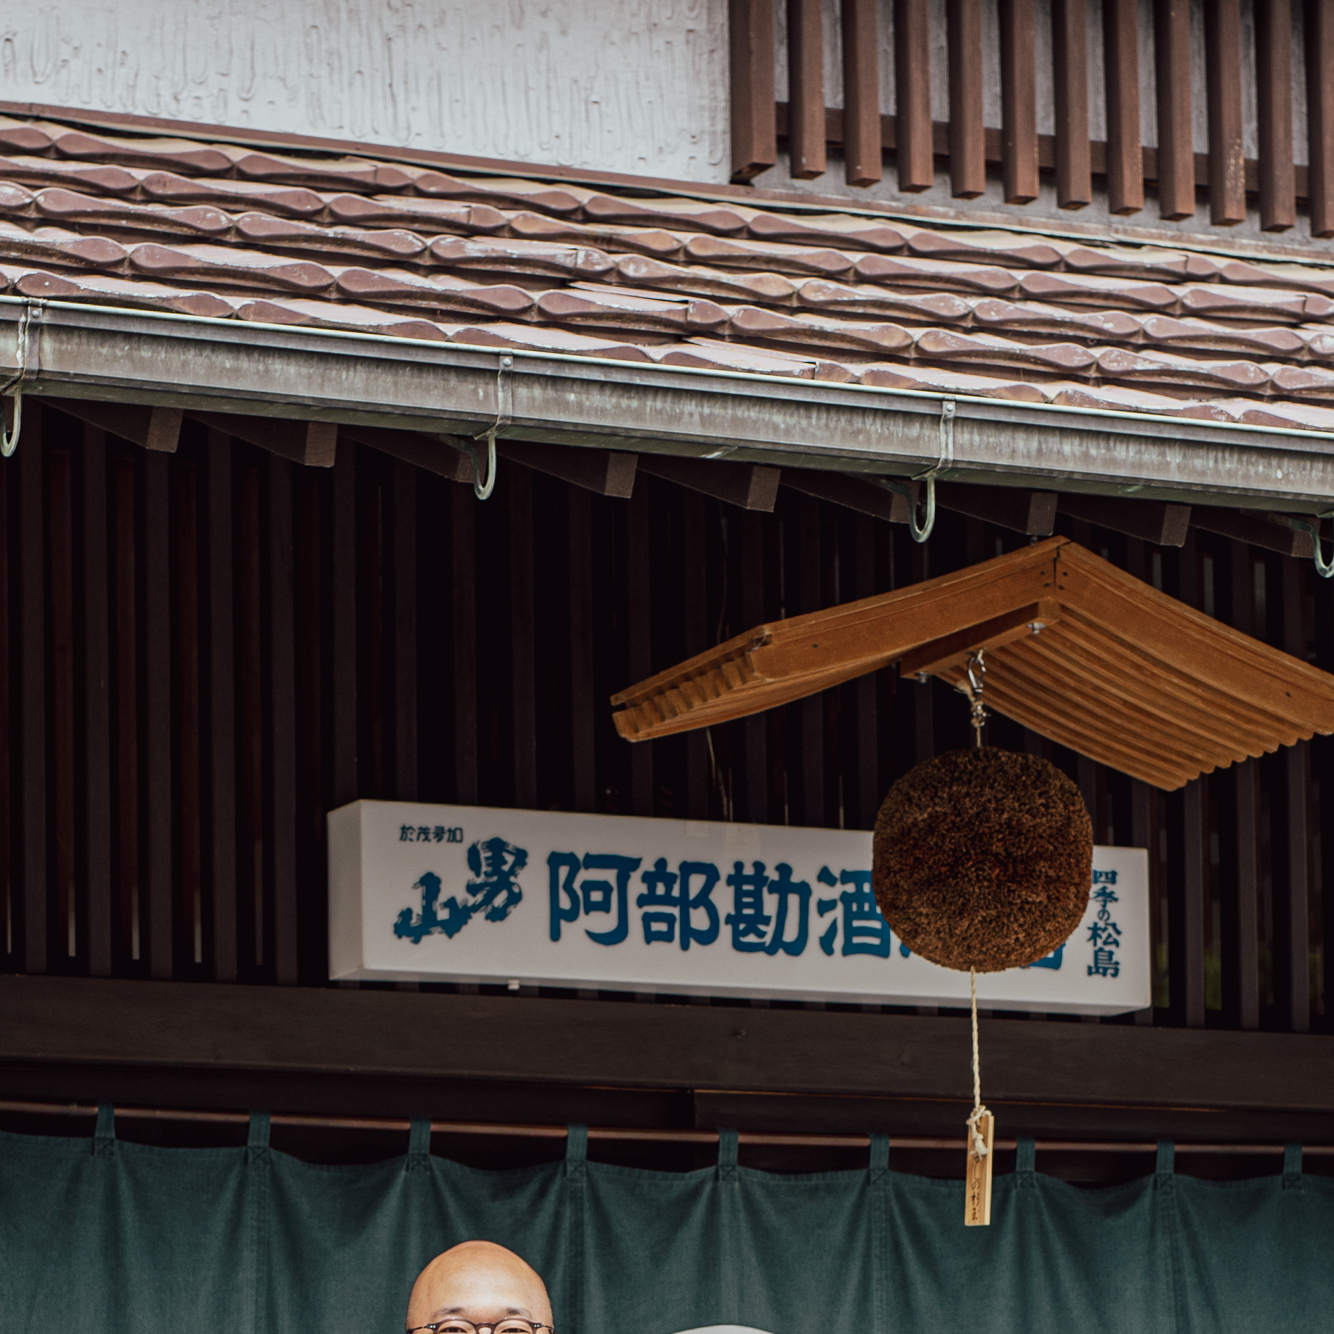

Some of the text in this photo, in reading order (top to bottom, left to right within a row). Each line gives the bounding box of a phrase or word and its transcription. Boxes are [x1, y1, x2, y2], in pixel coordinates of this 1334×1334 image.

[547, 850, 1064, 970] 阿部勘酒
[1087, 869, 1122, 978] 四季の松島
